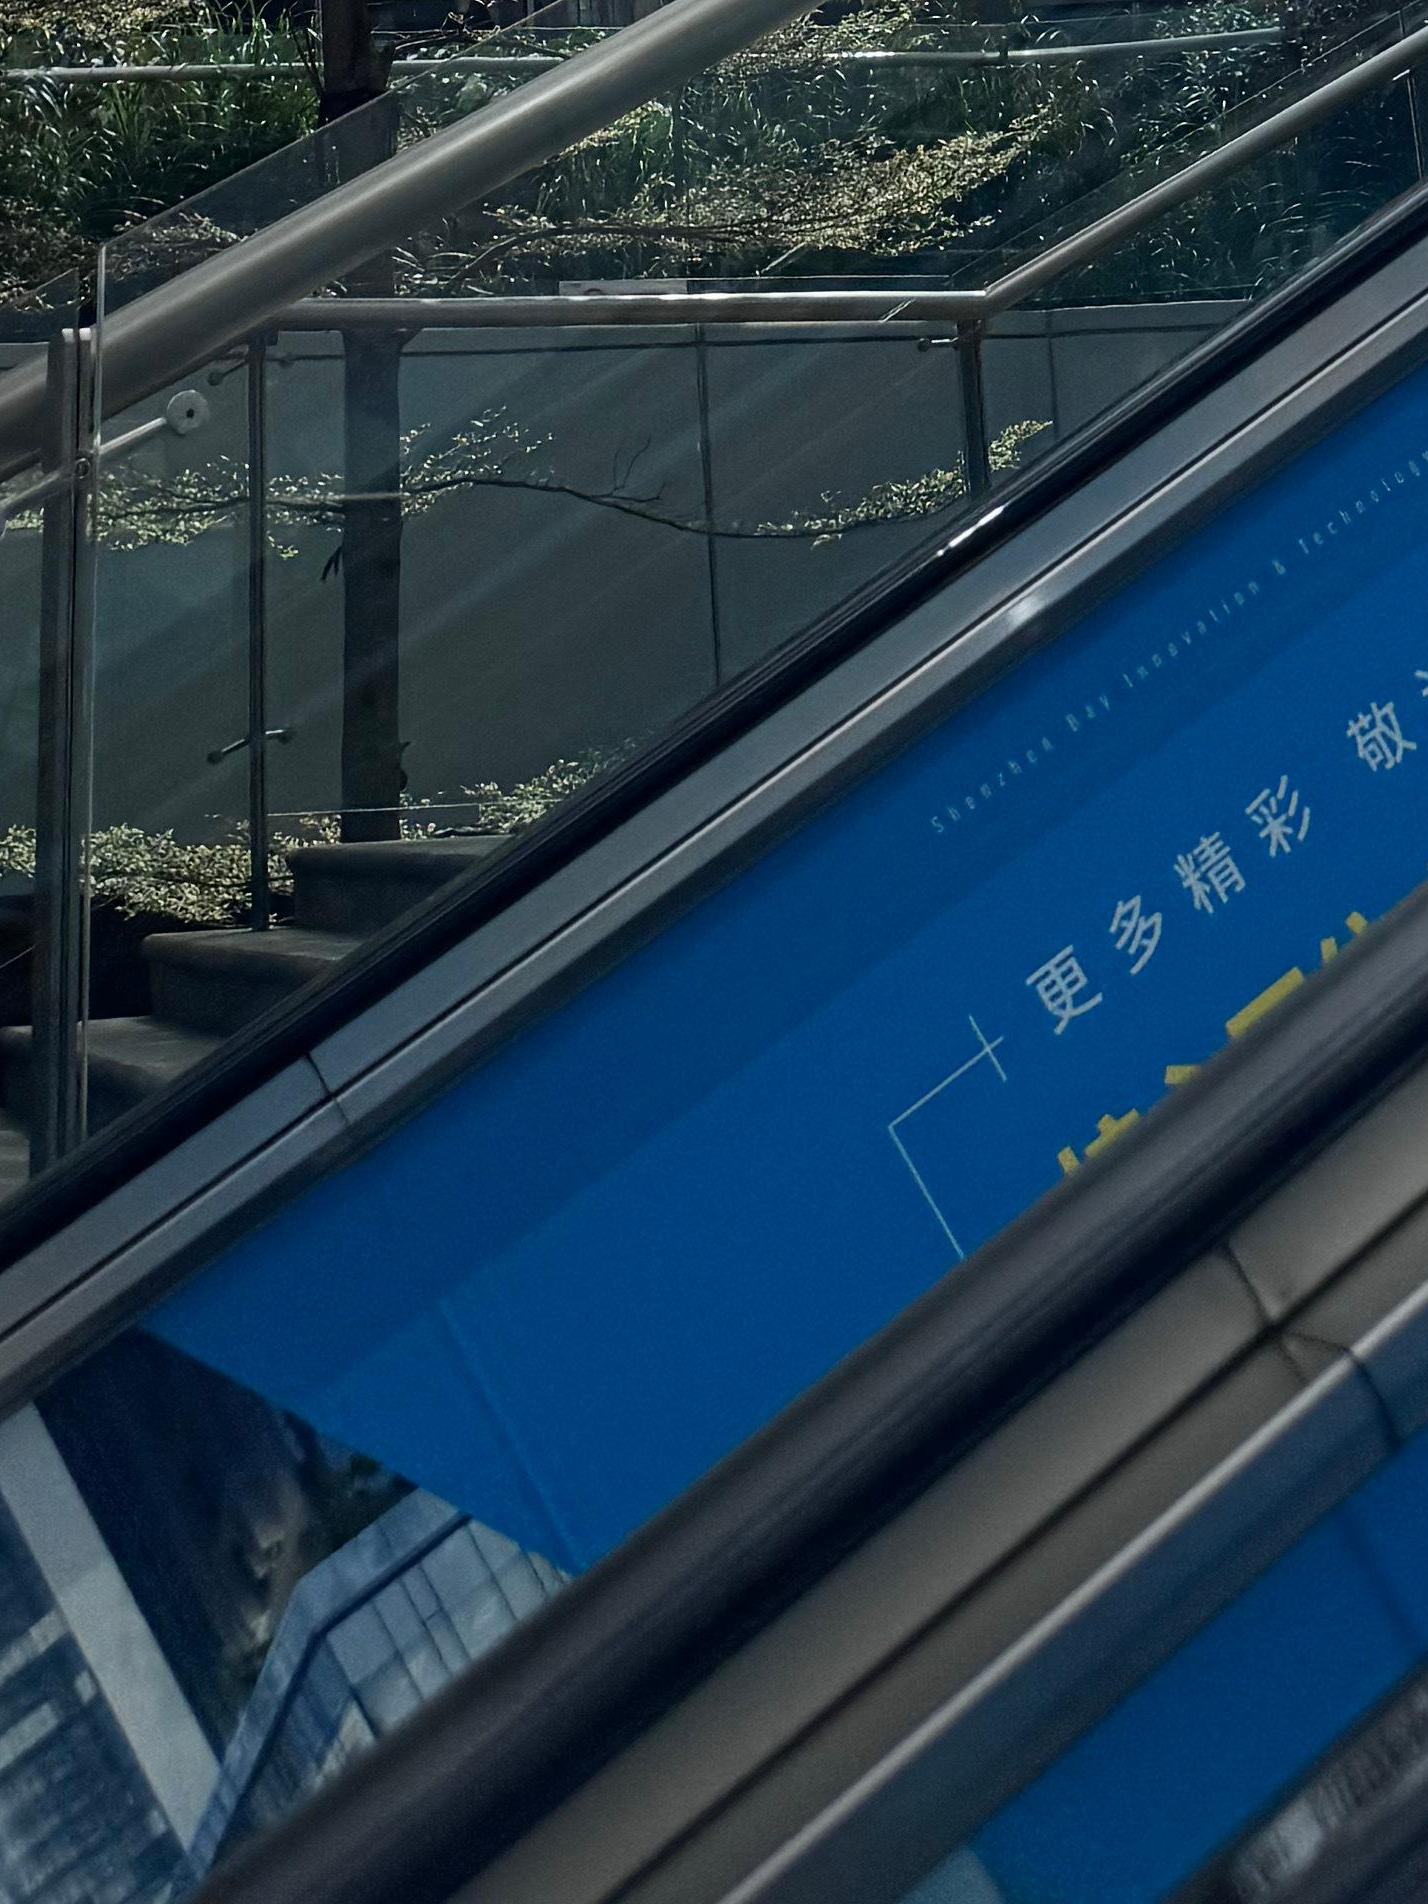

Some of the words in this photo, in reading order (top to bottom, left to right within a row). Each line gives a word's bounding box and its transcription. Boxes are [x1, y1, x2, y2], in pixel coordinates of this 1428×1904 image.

[932, 737, 1054, 833] Shenzhen
[1066, 694, 1110, 732] Bay
[1123, 581, 1260, 688] Innovation
[1025, 774, 1312, 1035] 更多精彩
